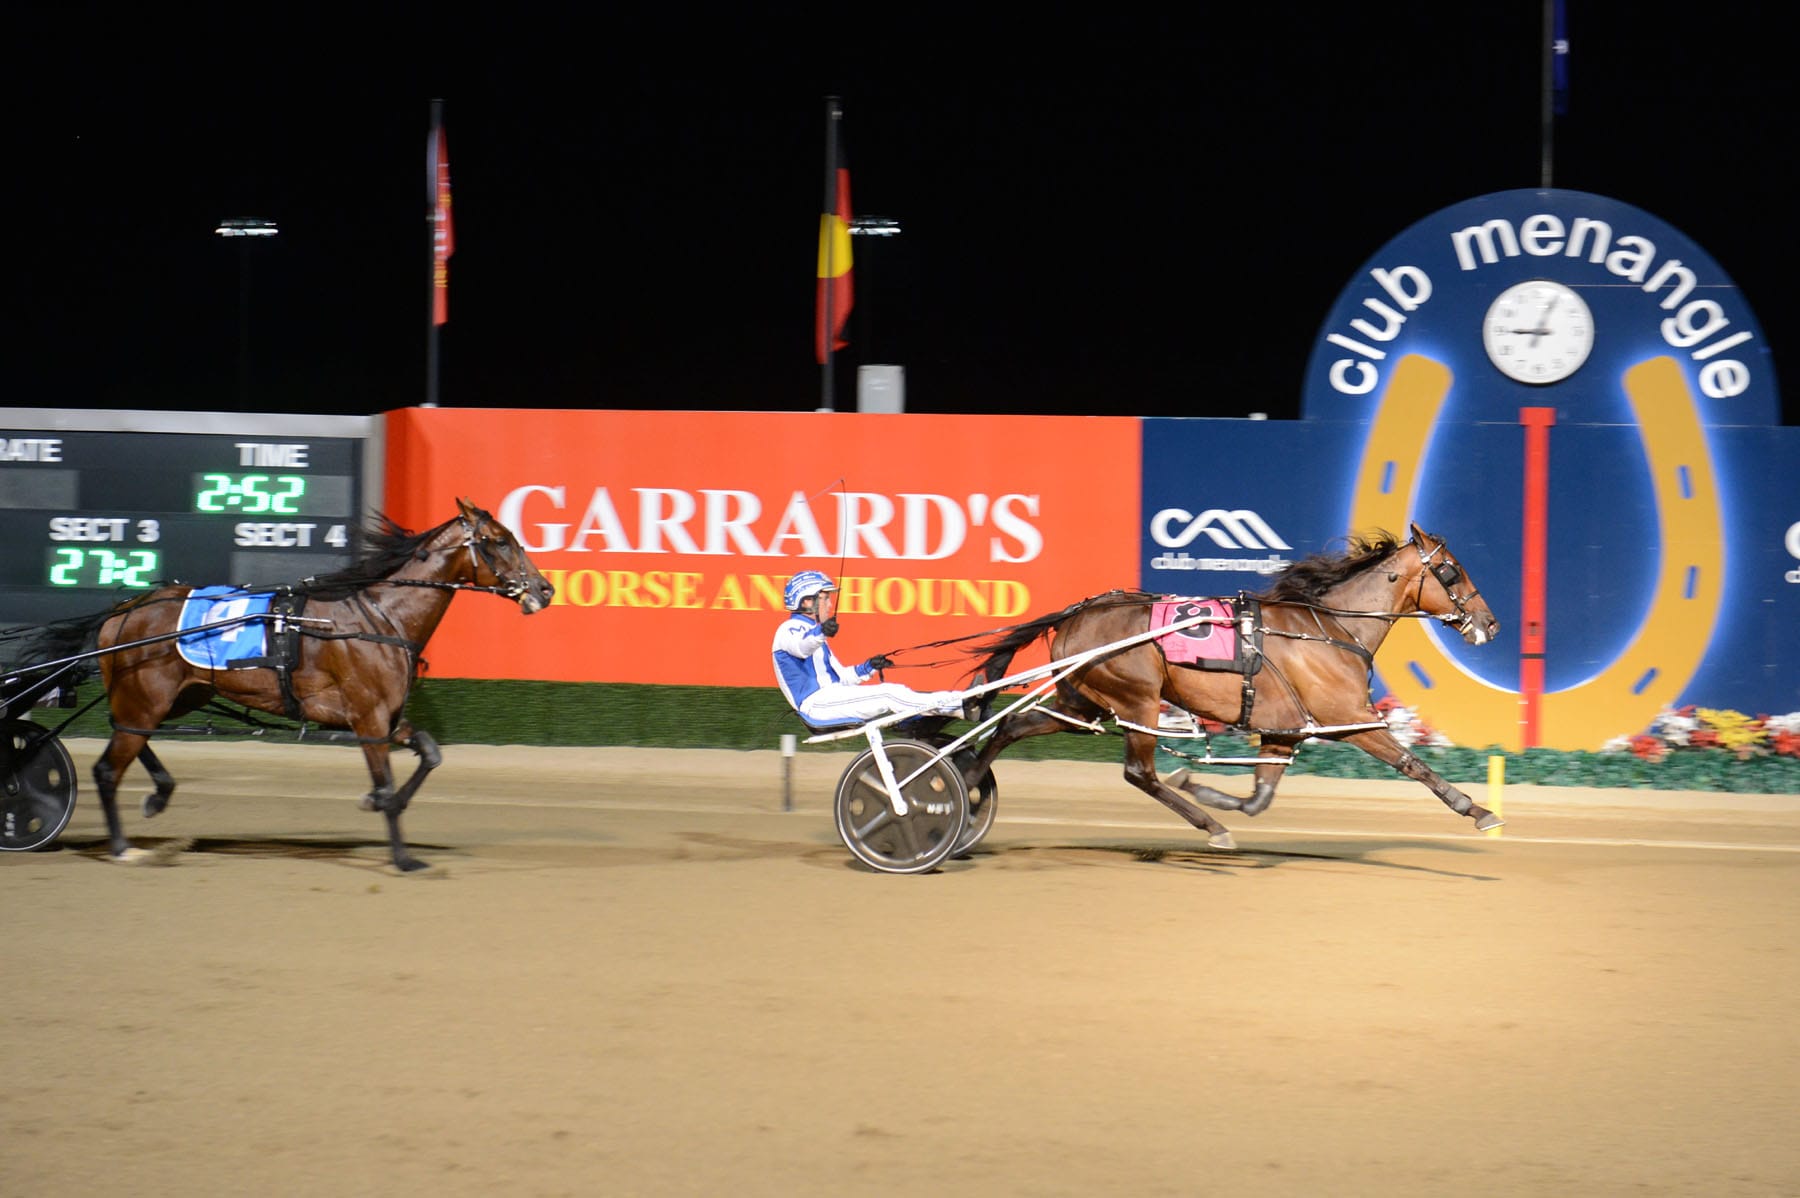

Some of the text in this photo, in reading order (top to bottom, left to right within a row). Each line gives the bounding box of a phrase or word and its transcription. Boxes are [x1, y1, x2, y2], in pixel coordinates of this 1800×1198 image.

[1326, 265, 1433, 396] club
[1450, 213, 1753, 399] menangle
[234, 442, 310, 468] TIME
[49, 516, 161, 543] SECT 3
[234, 522, 348, 548] SECT 4
[497, 484, 1044, 564] GARRARD'S
[709, 574, 793, 612] AN
[833, 576, 1031, 618] HOUND
[201, 598, 250, 642] 4
[1171, 601, 1214, 641] 8
